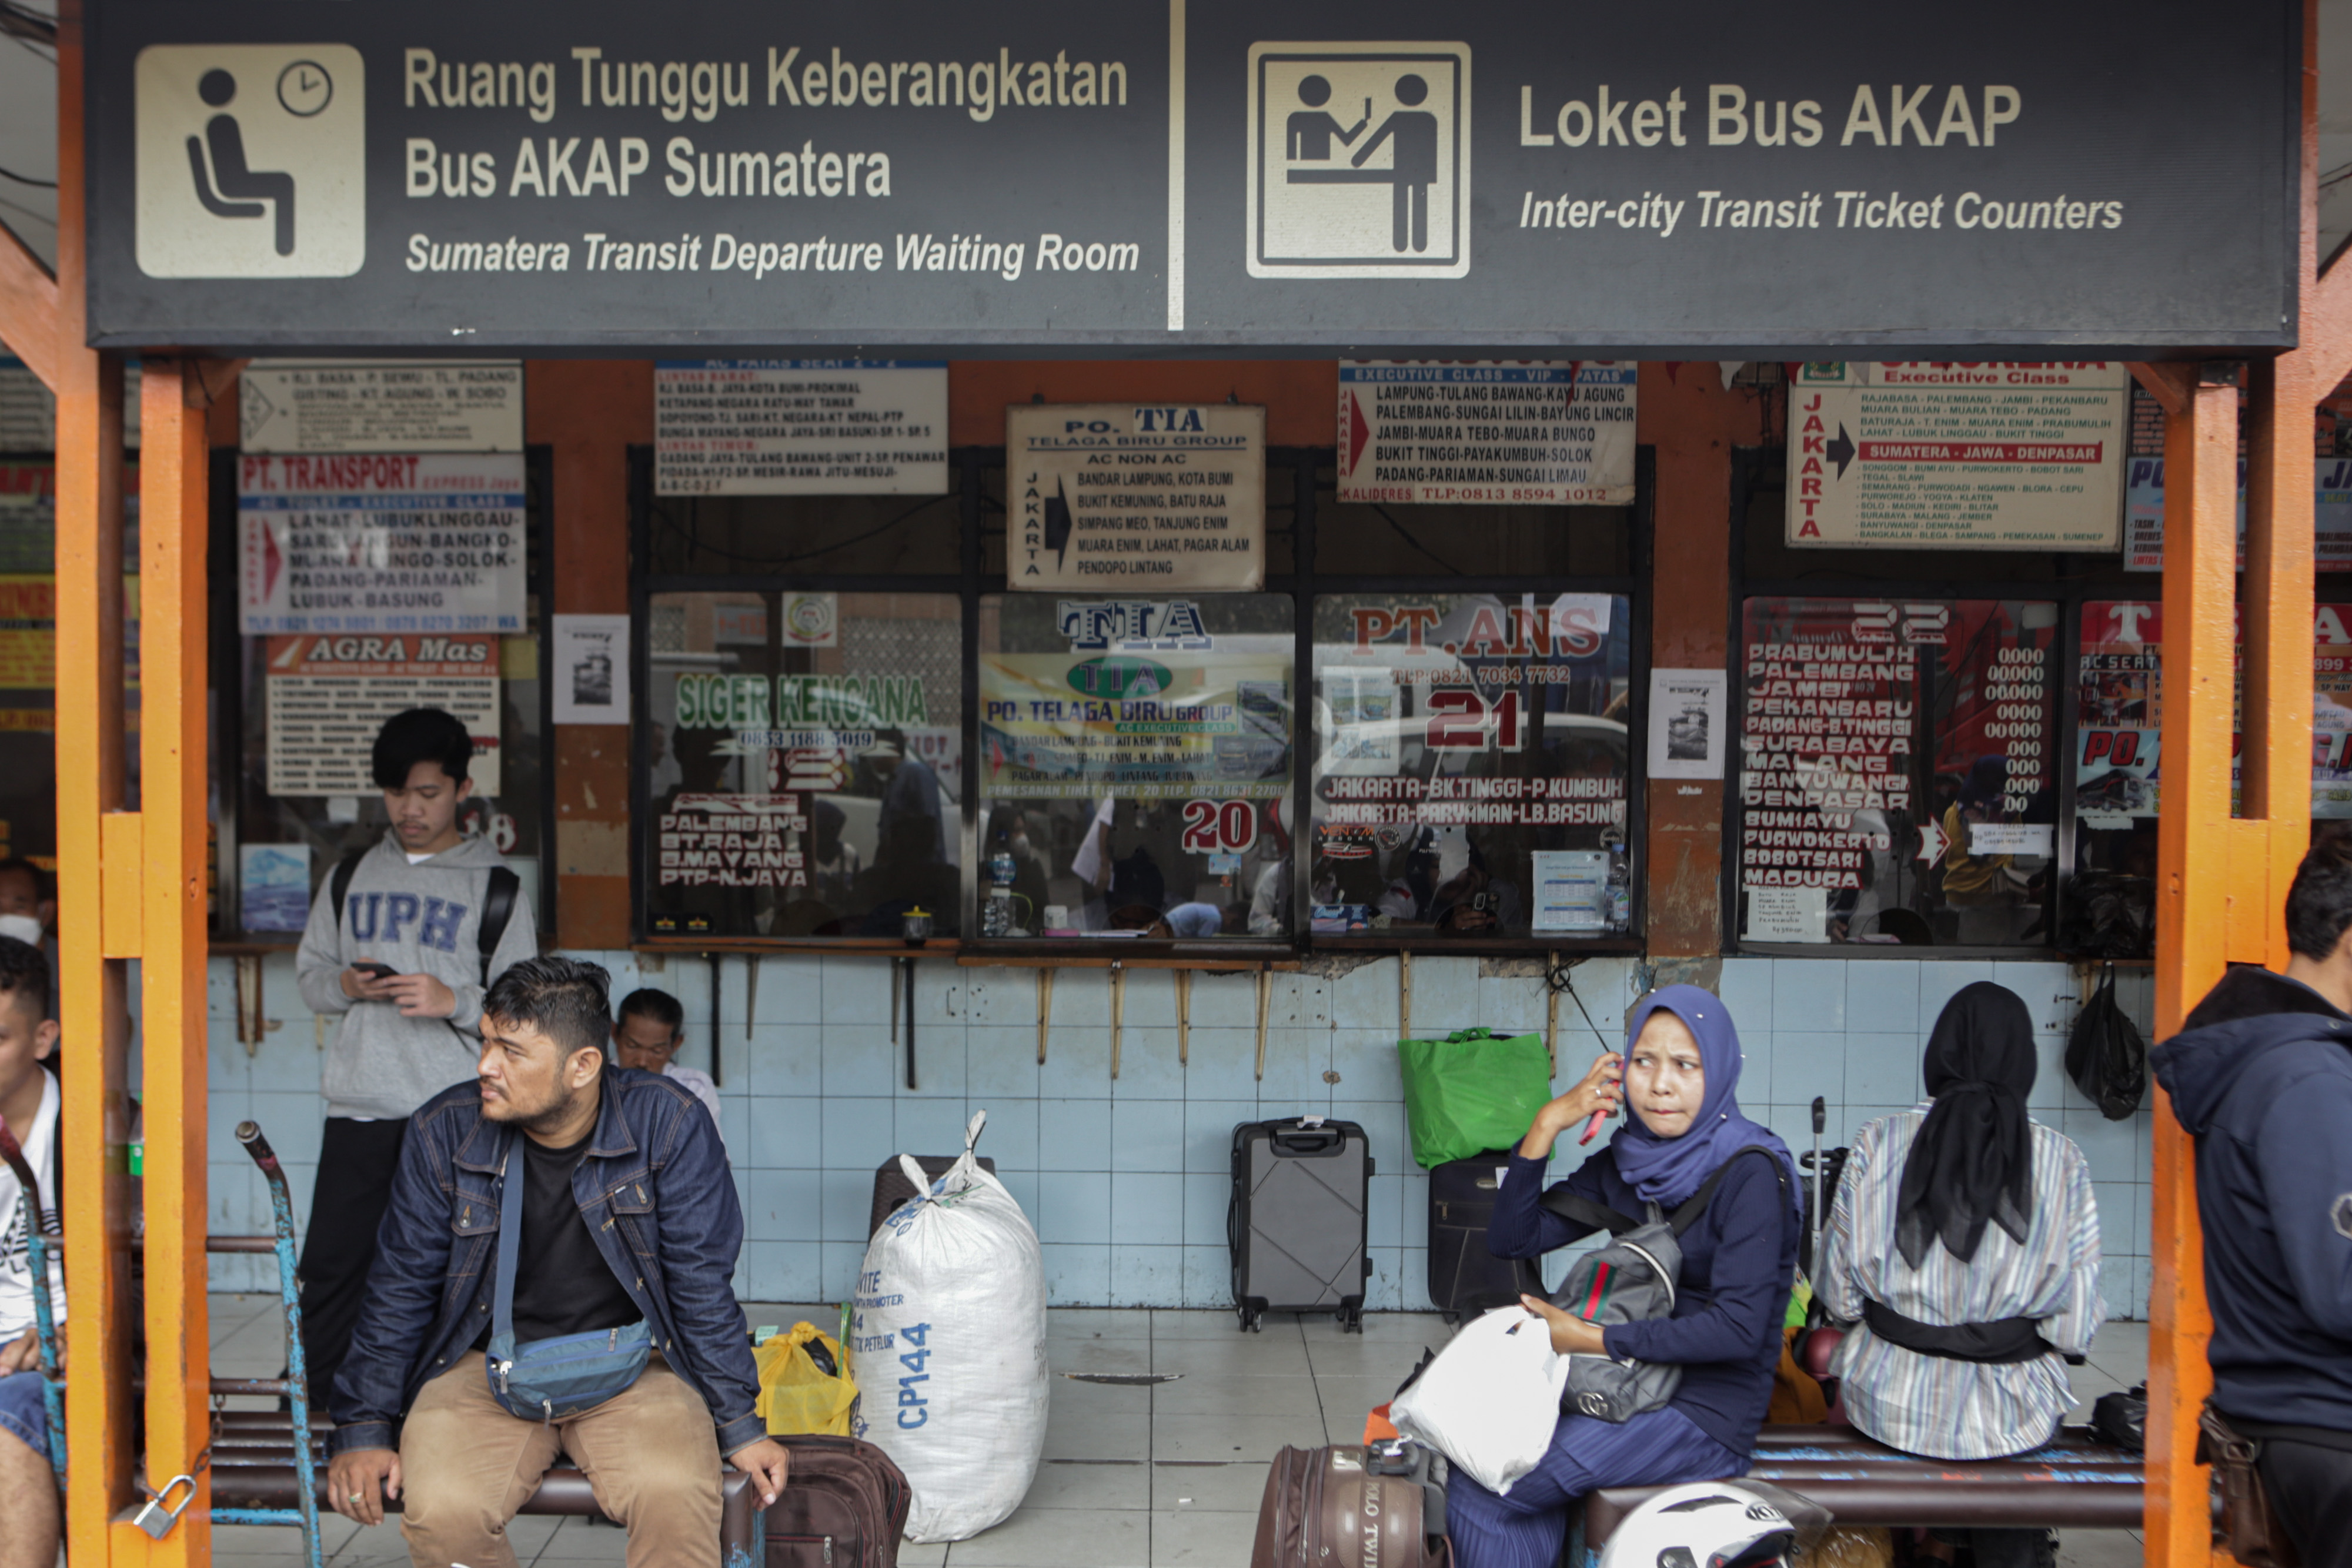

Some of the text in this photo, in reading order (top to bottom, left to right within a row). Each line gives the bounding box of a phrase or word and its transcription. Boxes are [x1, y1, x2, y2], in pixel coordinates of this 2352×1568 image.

[406, 48, 1126, 122] Ruang Tunggu Keberangkatan
[1521, 85, 2020, 147] Loket Bus AKAP
[407, 138, 890, 197] Bus AKAP Sumatera
[1521, 192, 2122, 237] Inter-city Transit Ticket Counters
[406, 234, 1138, 280] Sumatera Transit Departure Waiting Room
[1355, 369, 1622, 383] EXECUTIVE CLASS VIP PATAS
[1884, 371, 2070, 385] Executive Class
[1861, 394, 2108, 405] RAJABASA PALEMBANG JAMBI PEKANBARU
[1377, 405, 1633, 421] PALEMBANG-SUNGAI LILIN-BAYUNG LINCIR
[1861, 405, 2072, 416] MUARA BULIAN MUARA TEBO PADANG
[1065, 408, 1204, 433] PO. TIA
[1860, 417, 2111, 429] BATURAJA ENIM MUARA PRABUMULIH
[1027, 437, 1247, 446] TELAGA BIRU GROUP
[1339, 390, 1348, 477] JAKARTA
[1377, 426, 1595, 441] JAMBI-MUARA TEBO-MUARA BUNGO
[1860, 428, 2064, 439] LAHAT LUBUK LINGGAU BUKIT TINGGI
[893, 453, 946, 463] PENAWAR
[1088, 454, 1185, 464] AC NON AC
[1377, 447, 1591, 462] BUKIT TINGGI-PAYAKUMBUH-SOLOK
[1871, 446, 2094, 459] SUMATERA JAWA DENPASAR
[243, 456, 420, 490] PT. TRANSPORT
[1377, 467, 1585, 482] PADANG-PARIAMAN-SUNGAI LIMAU
[1799, 394, 1825, 538] JAKARTA
[1962, 465, 2023, 473] PURWOKERTO
[1078, 473, 1232, 487] BANDAR LAMPUNG, KOTA BUMI
[1078, 495, 1225, 510] BUKIT KEMUNING, BATU RAJA
[1344, 489, 1411, 500] KALIDERES
[1422, 488, 1606, 501] TLP:0813 8594 1012
[1025, 472, 1041, 576] JAKARTA
[1078, 517, 1227, 531] SIMPANG MEO, TANJUNG ENIM
[1861, 511, 1906, 520] SURABAYA
[2133, 519, 2154, 530] TASIK
[1078, 539, 1248, 553] MUARA ENIM, LAHAT, PAGAR ALAM
[1078, 561, 1172, 574] PENDOPO LINTANG
[1058, 599, 1213, 651] TIA
[307, 636, 489, 663] AGRA Mas
[1748, 644, 1915, 663] PRABUMULIH
[1748, 662, 1914, 681] PALEMBANG
[2080, 656, 2156, 669] AC SEAT
[1080, 663, 1160, 691] TIA
[1392, 665, 1570, 685] TLP:0821 7034 7732
[1748, 681, 1850, 698] JAMBI
[676, 674, 771, 729] SIGER
[987, 700, 1233, 722] PO. TELAGA BIRU GROUP
[1747, 699, 1913, 717] PEKANBARU
[1118, 723, 1134, 733] AC
[1137, 723, 1195, 733] EXECUTIVE
[1425, 689, 1522, 753] 21
[1746, 717, 1912, 737] PADANG-B.TINGGI
[1745, 735, 1910, 755] SURABAYA
[2082, 731, 2144, 766] PO.
[1745, 753, 1887, 773] MALANG
[1324, 776, 1626, 800] JAKARTA-BK.TINGGI-P.KUMBUH
[1745, 771, 1910, 791] BANYUWANGI
[1744, 790, 1909, 810] DENPASAR
[660, 815, 808, 833] PALEMBANG
[1182, 800, 1257, 854] 20
[1744, 810, 1854, 829] BUMIAYU
[660, 833, 783, 850] BT.RAJA
[1744, 830, 1891, 851] PURWOKERTO
[660, 851, 804, 868] B.MAYANG
[1743, 848, 1863, 867] BOBOTSARI
[1743, 868, 1860, 888] MADURA
[348, 891, 467, 954] UPH
[897, 1323, 931, 1429] CP144
